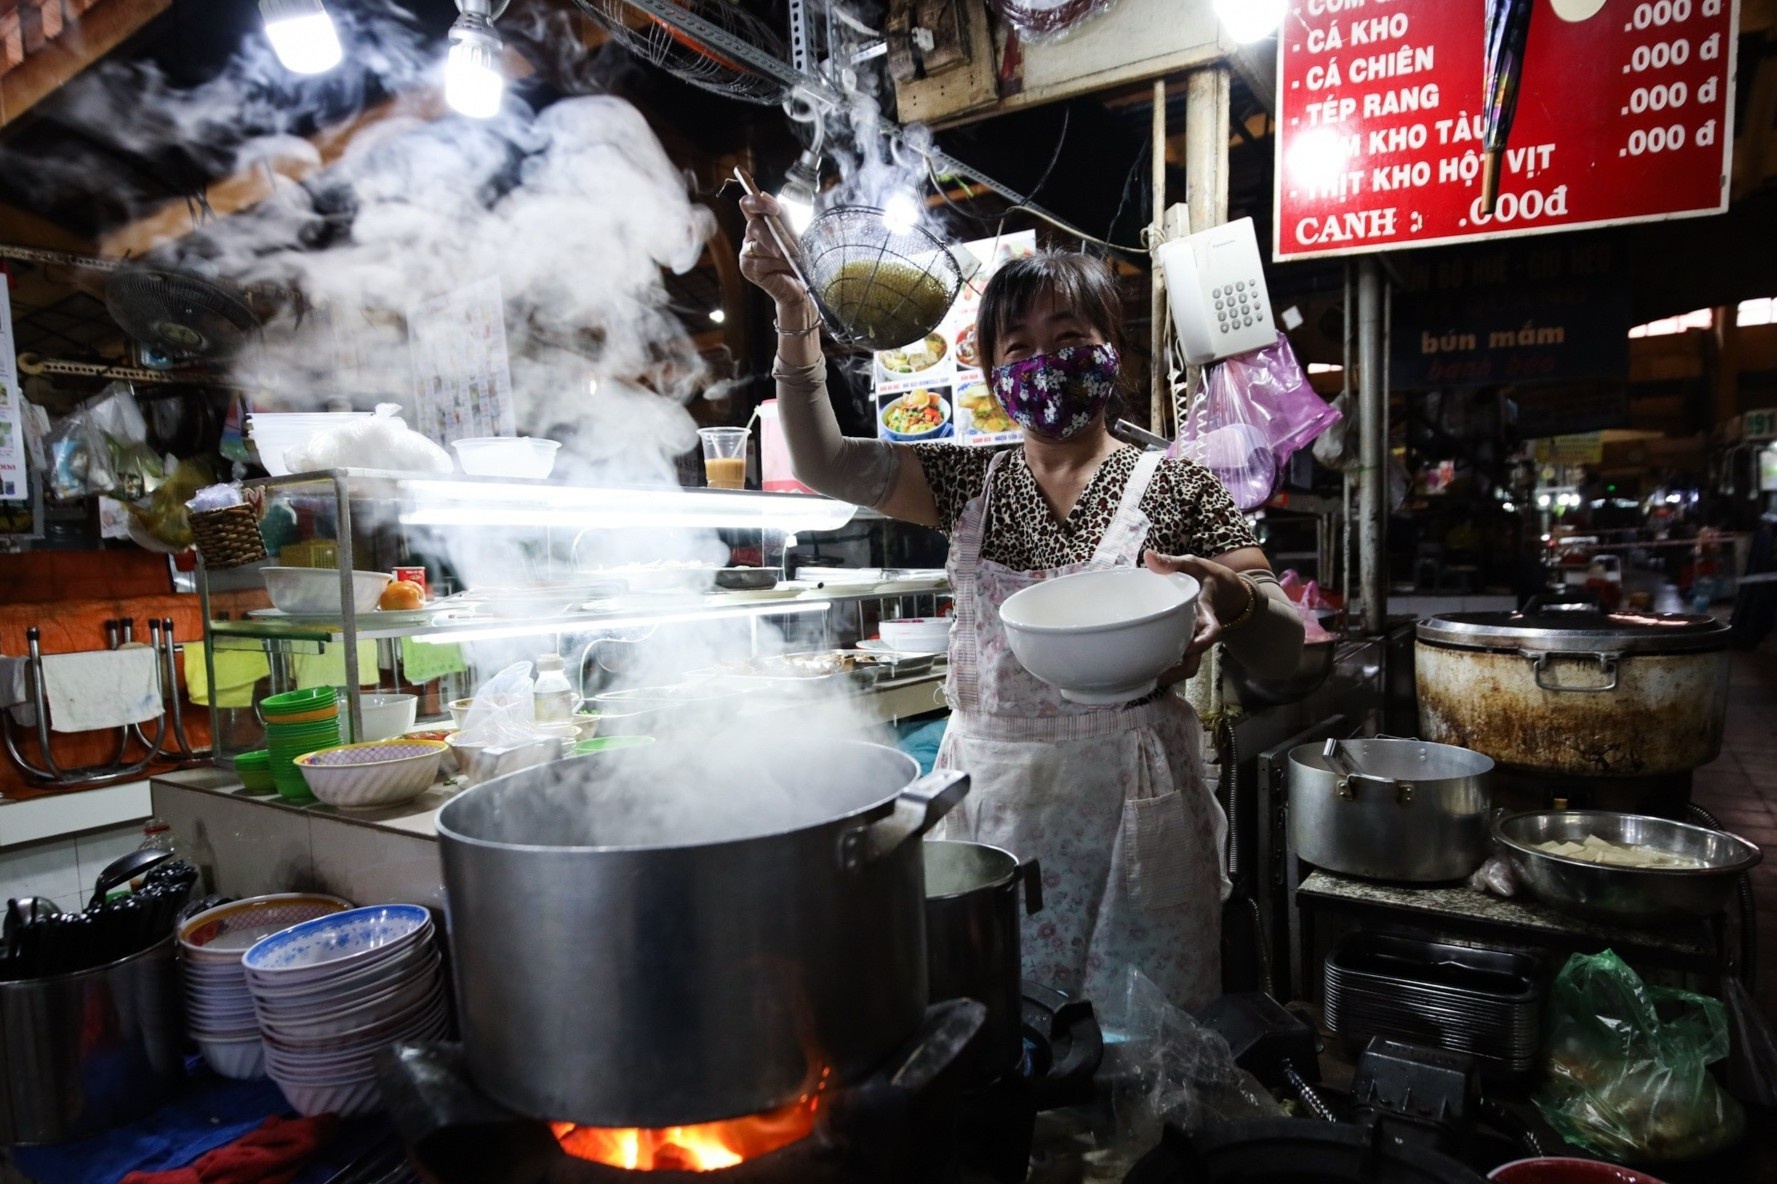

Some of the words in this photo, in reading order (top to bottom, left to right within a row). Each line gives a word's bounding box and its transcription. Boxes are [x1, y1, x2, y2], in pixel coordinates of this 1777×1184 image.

[1307, 19, 1343, 54] CÁ
[1350, 12, 1409, 46] KHO
[1306, 57, 1342, 91] CÁ
[1349, 45, 1435, 84] CHIÊN
[1622, 38, 1690, 74] .000
[1305, 95, 1357, 126] TÉP
[1362, 83, 1440, 119] RANG
[1620, 81, 1688, 116] .000
[1368, 123, 1428, 156] KHO
[1618, 123, 1686, 158] .000
[1371, 160, 1431, 192] KHO
[1506, 144, 1556, 179] VỊT
[1295, 208, 1397, 246] CANH
[1421, 329, 1477, 353] bún
